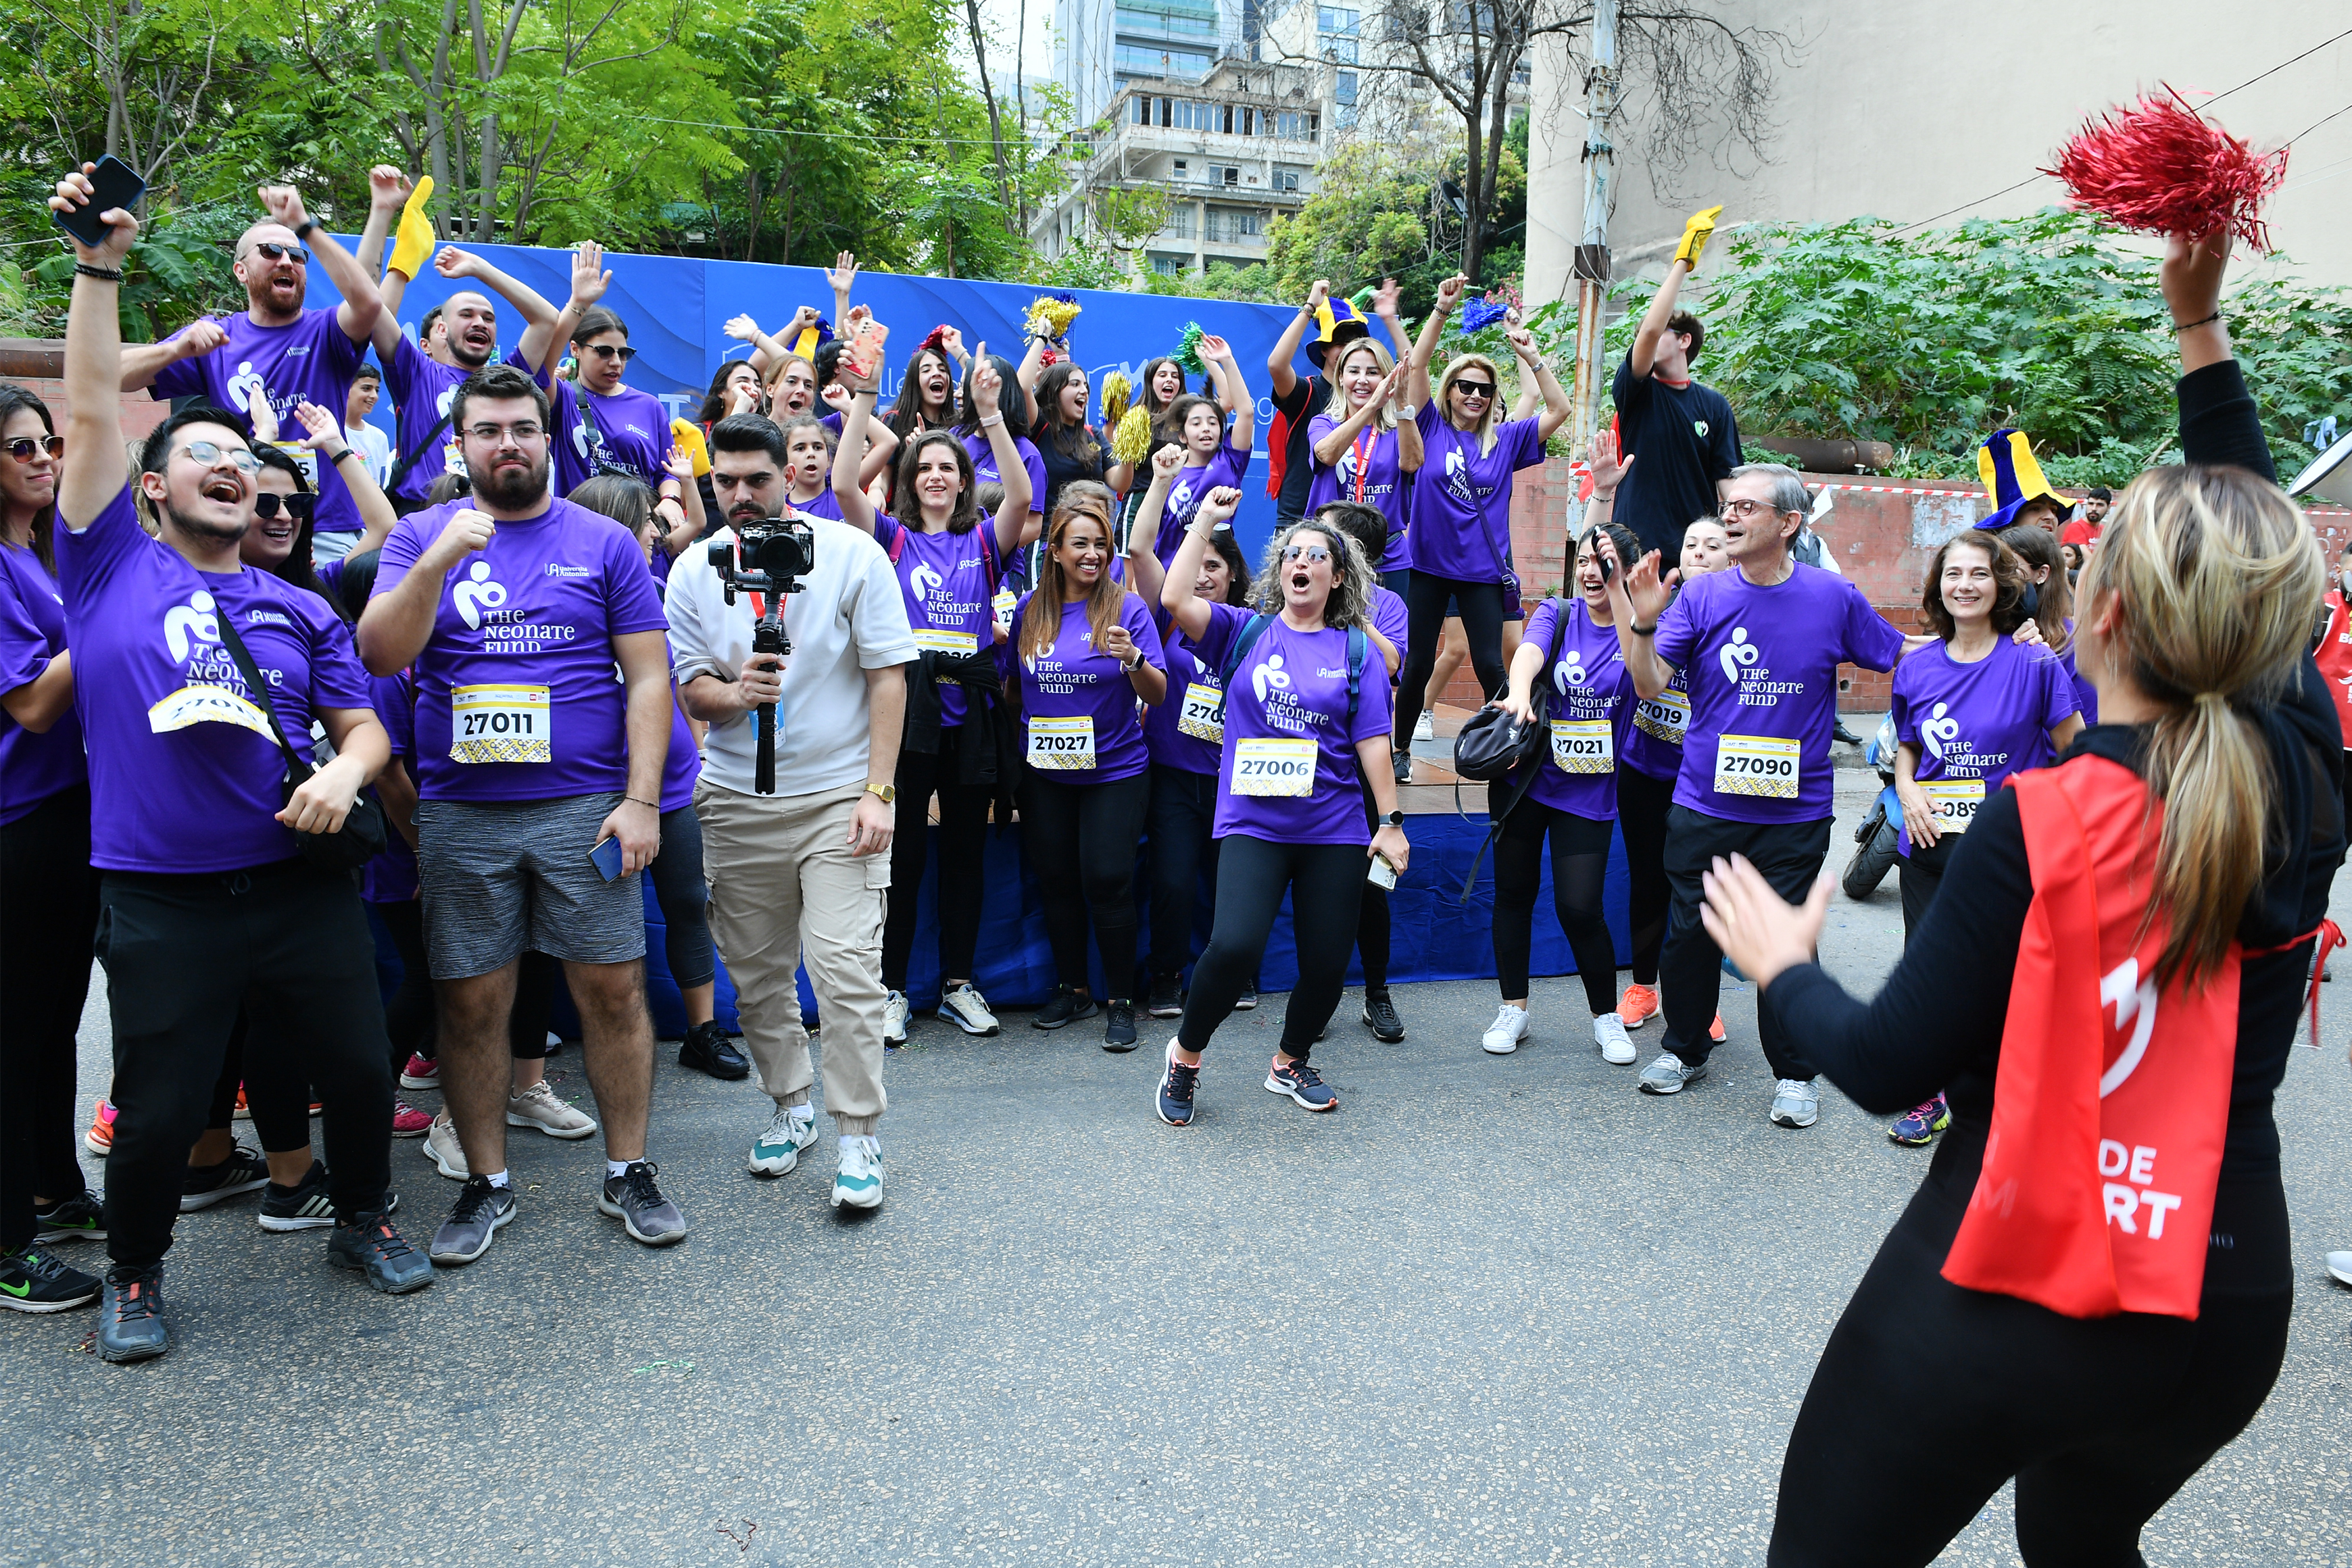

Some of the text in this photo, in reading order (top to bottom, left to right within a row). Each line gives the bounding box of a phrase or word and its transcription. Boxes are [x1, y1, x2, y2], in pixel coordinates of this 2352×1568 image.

[464, 712, 533, 736] 27011
[1035, 736, 1087, 750] 27027
[1240, 760, 1309, 776] 27006
[1723, 756, 1792, 776] 27090
